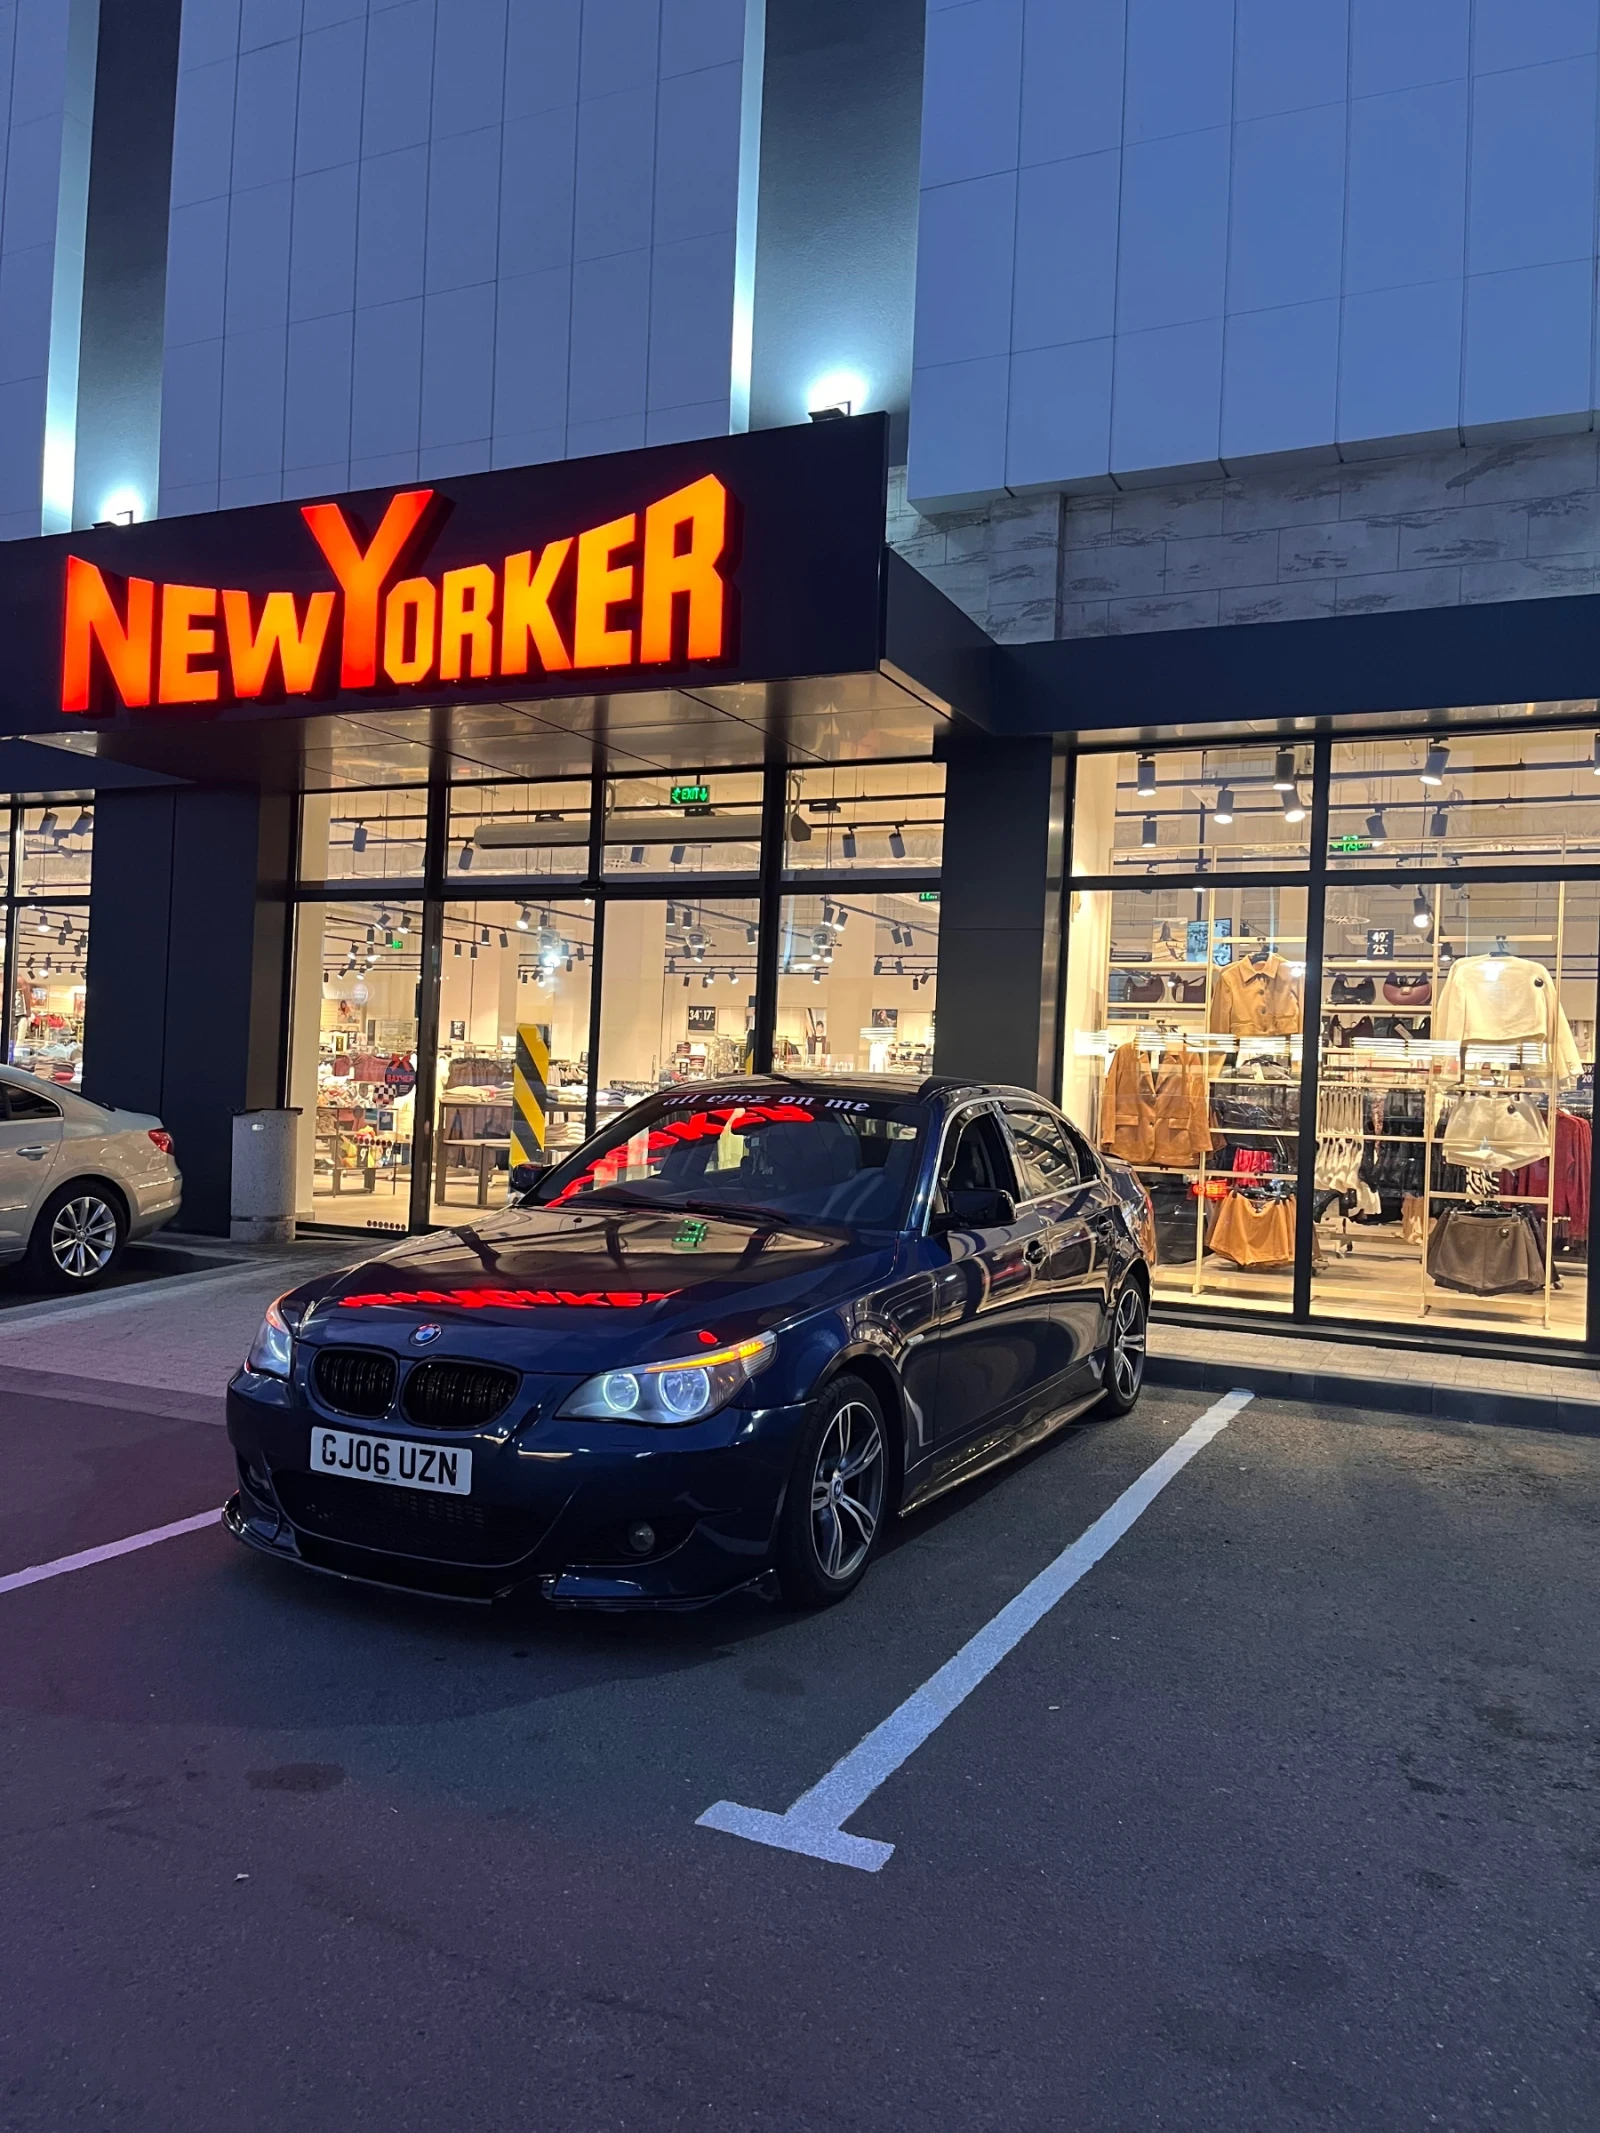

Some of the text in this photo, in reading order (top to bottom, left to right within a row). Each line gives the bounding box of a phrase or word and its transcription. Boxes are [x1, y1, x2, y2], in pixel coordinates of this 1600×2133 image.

[681, 787, 700, 800] EXIT
[662, 1094, 701, 1107] all
[778, 1096, 813, 1106] on
[825, 1099, 870, 1112] me
[322, 1434, 458, 1486] GJ06 UZN
